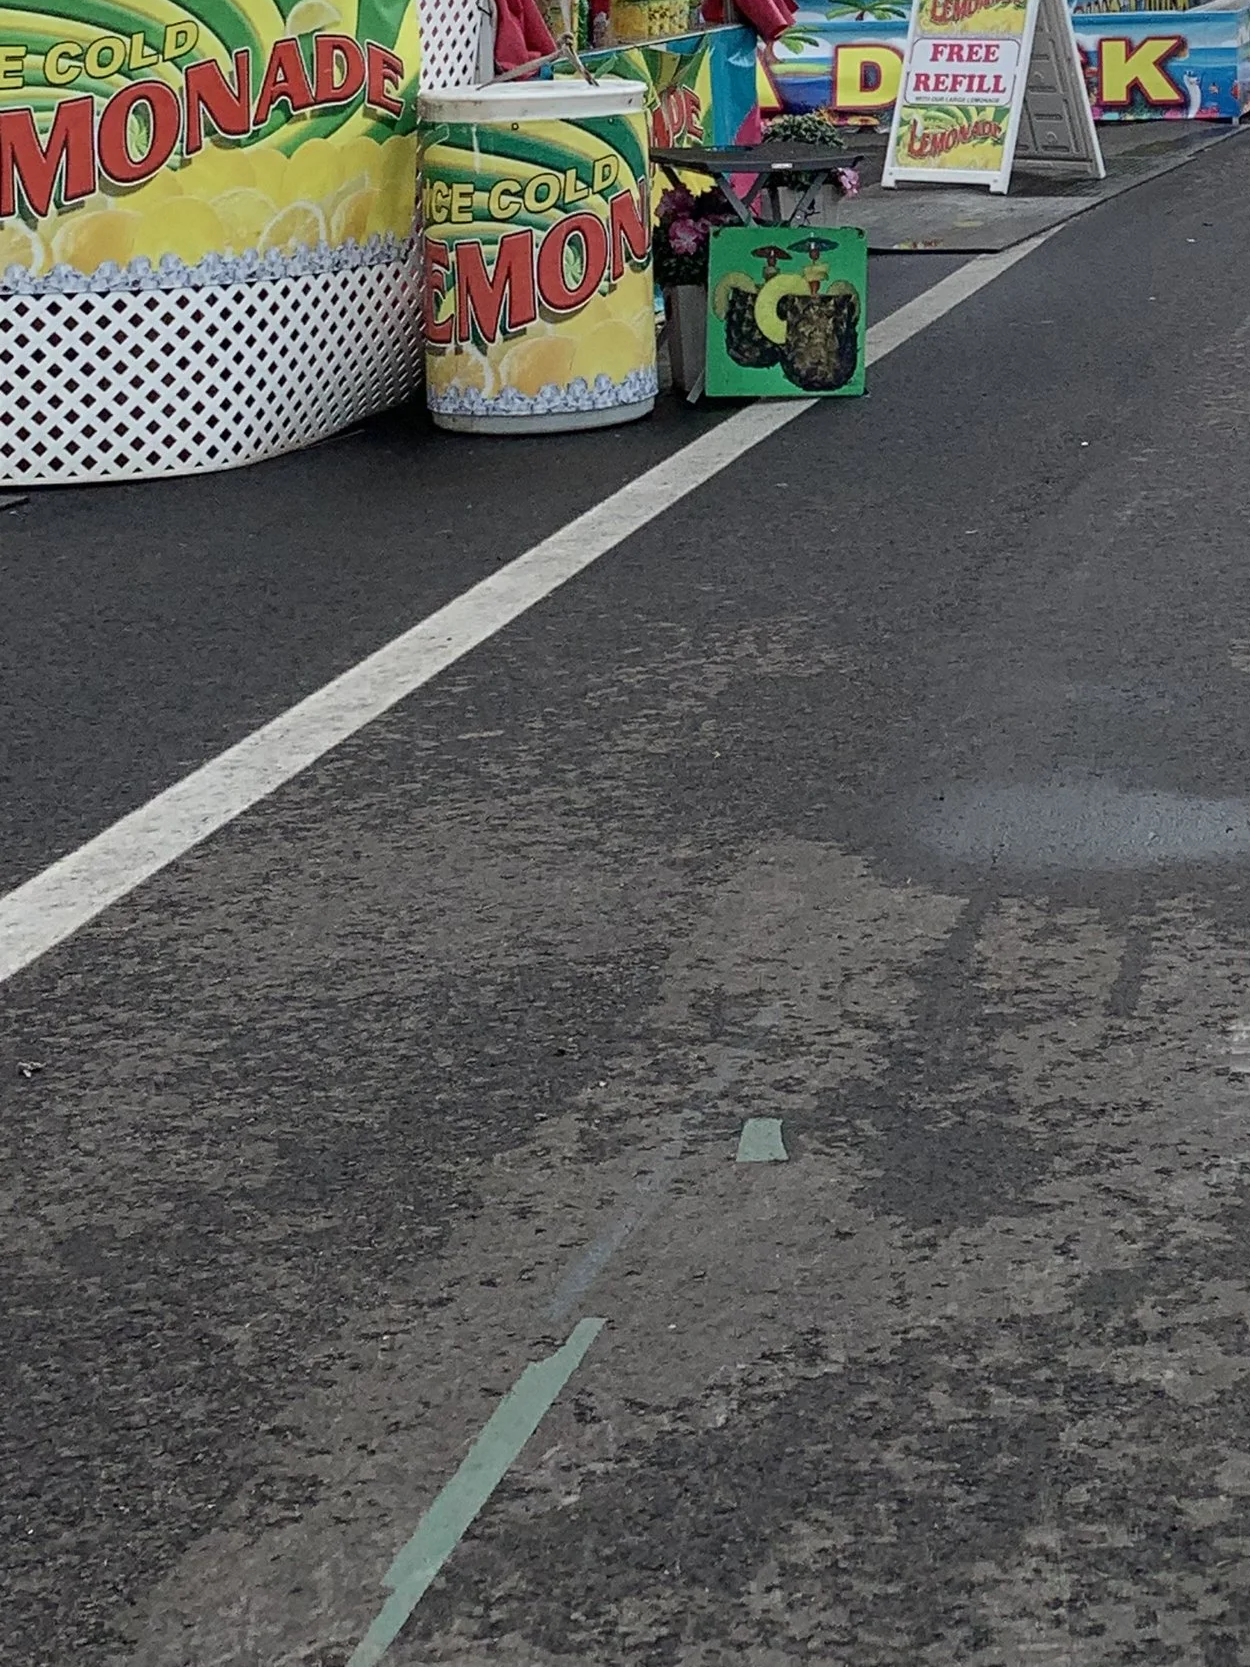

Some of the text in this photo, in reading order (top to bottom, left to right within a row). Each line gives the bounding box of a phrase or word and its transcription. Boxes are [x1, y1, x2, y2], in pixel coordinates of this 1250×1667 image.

[44, 20, 199, 86] COLD
[929, 43, 1000, 63] FREE
[912, 73, 1007, 94] REFILL
[0, 31, 406, 220] MONADE
[908, 118, 1003, 160] LEMONADE
[425, 153, 620, 223] ICE COLD
